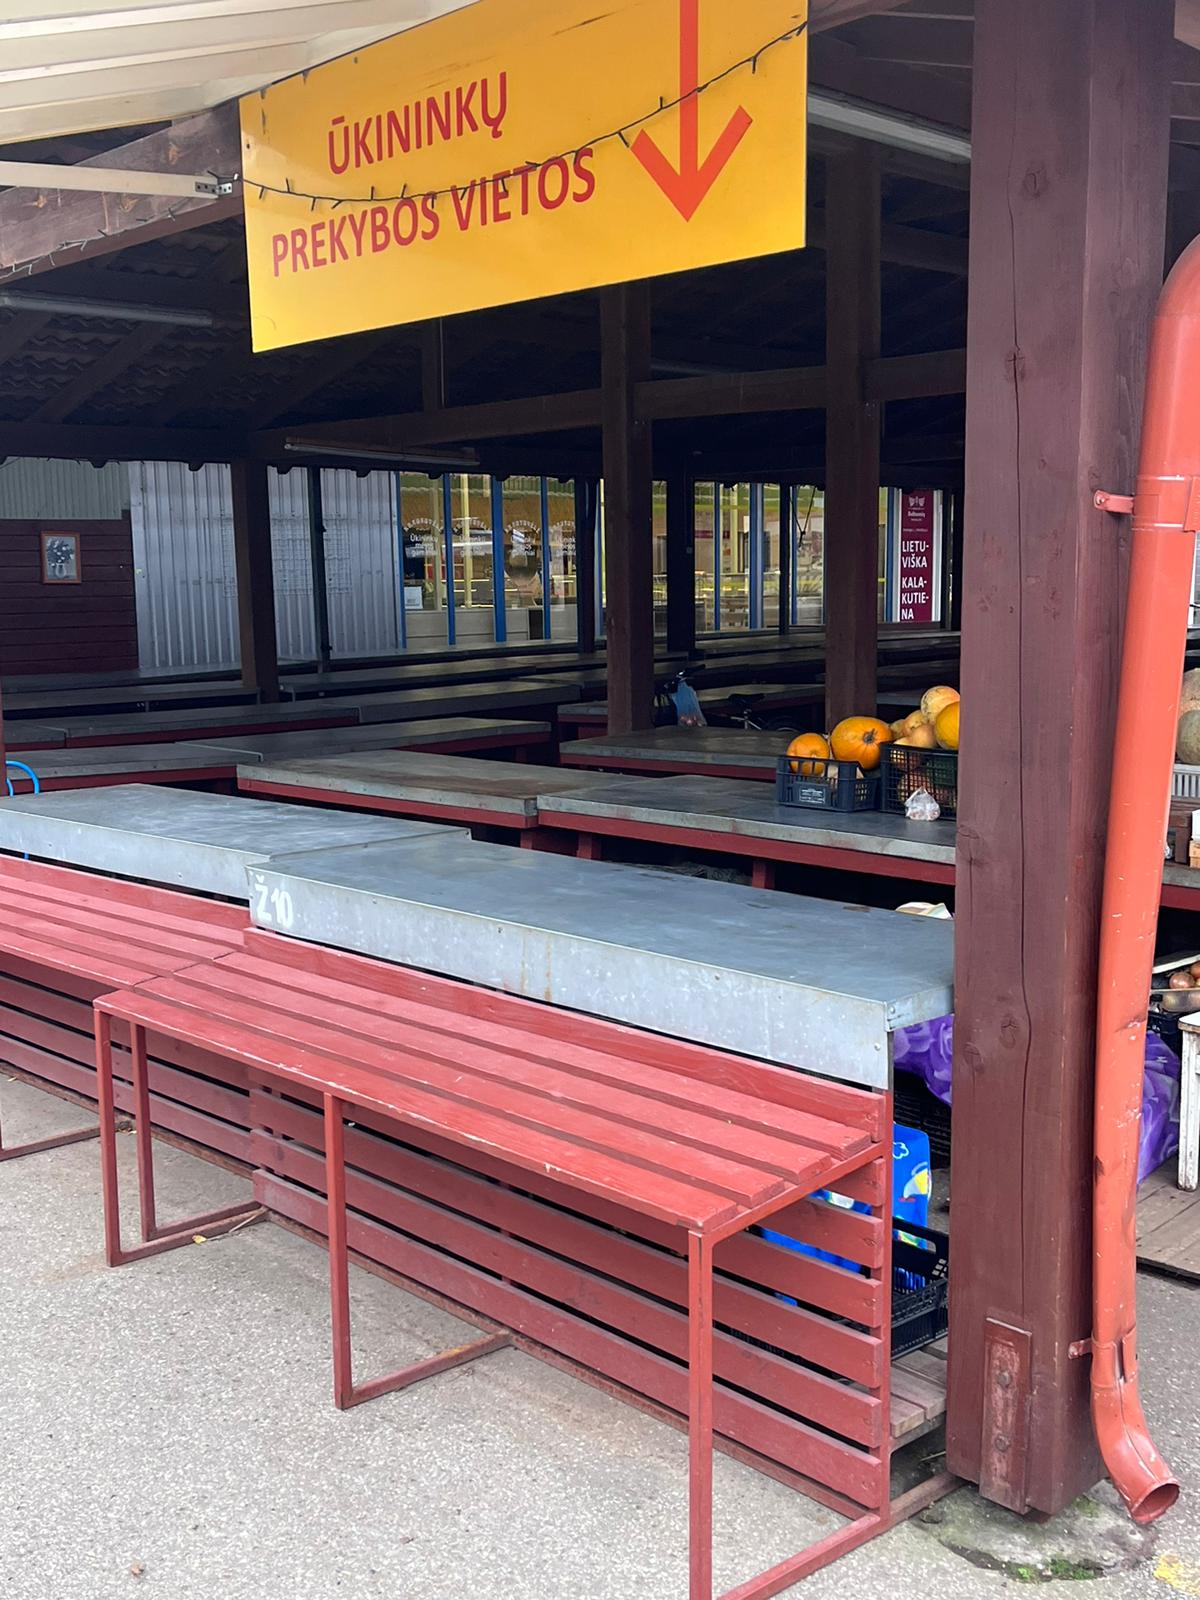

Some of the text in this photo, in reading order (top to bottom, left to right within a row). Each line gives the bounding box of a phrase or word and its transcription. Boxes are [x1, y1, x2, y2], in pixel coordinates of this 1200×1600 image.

[328, 71, 507, 175] ŪKININKŲ
[272, 147, 596, 277] PREKYBOS VIETOS
[902, 541, 930, 552] LIETU-
[901, 553, 928, 568] VIŠKA
[902, 576, 927, 588] KALA-
[901, 592, 930, 604] KUTIE-
[901, 608, 914, 620] NA
